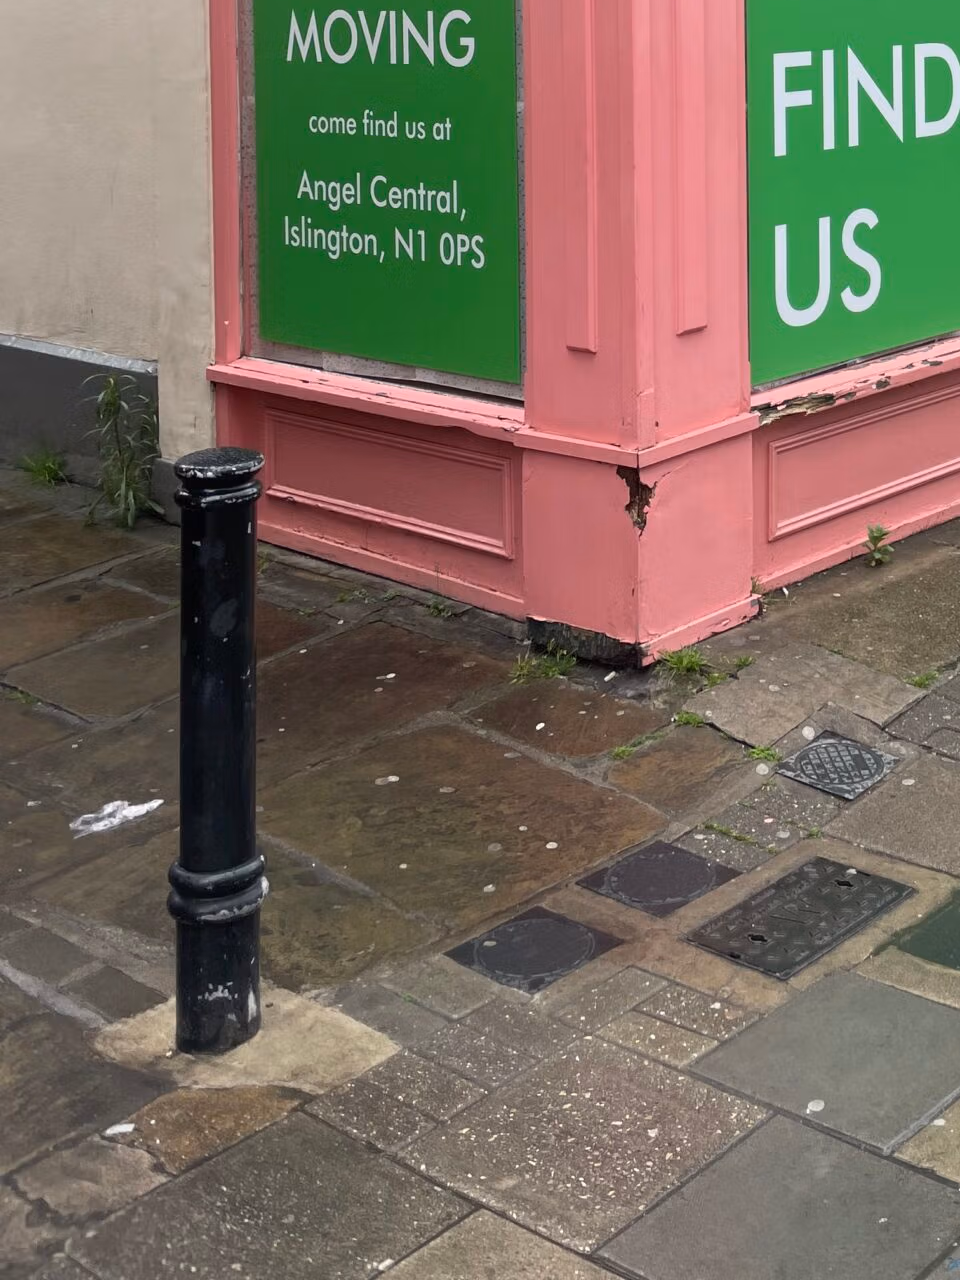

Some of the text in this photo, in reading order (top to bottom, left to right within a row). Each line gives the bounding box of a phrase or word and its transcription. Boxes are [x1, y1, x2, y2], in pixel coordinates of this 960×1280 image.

[286, 9, 475, 68] MOVING
[308, 111, 452, 141] come find us at
[297, 170, 467, 222] Angel Central,
[284, 215, 386, 264] Islington,
[394, 227, 427, 262] N1
[774, 207, 882, 328] US
